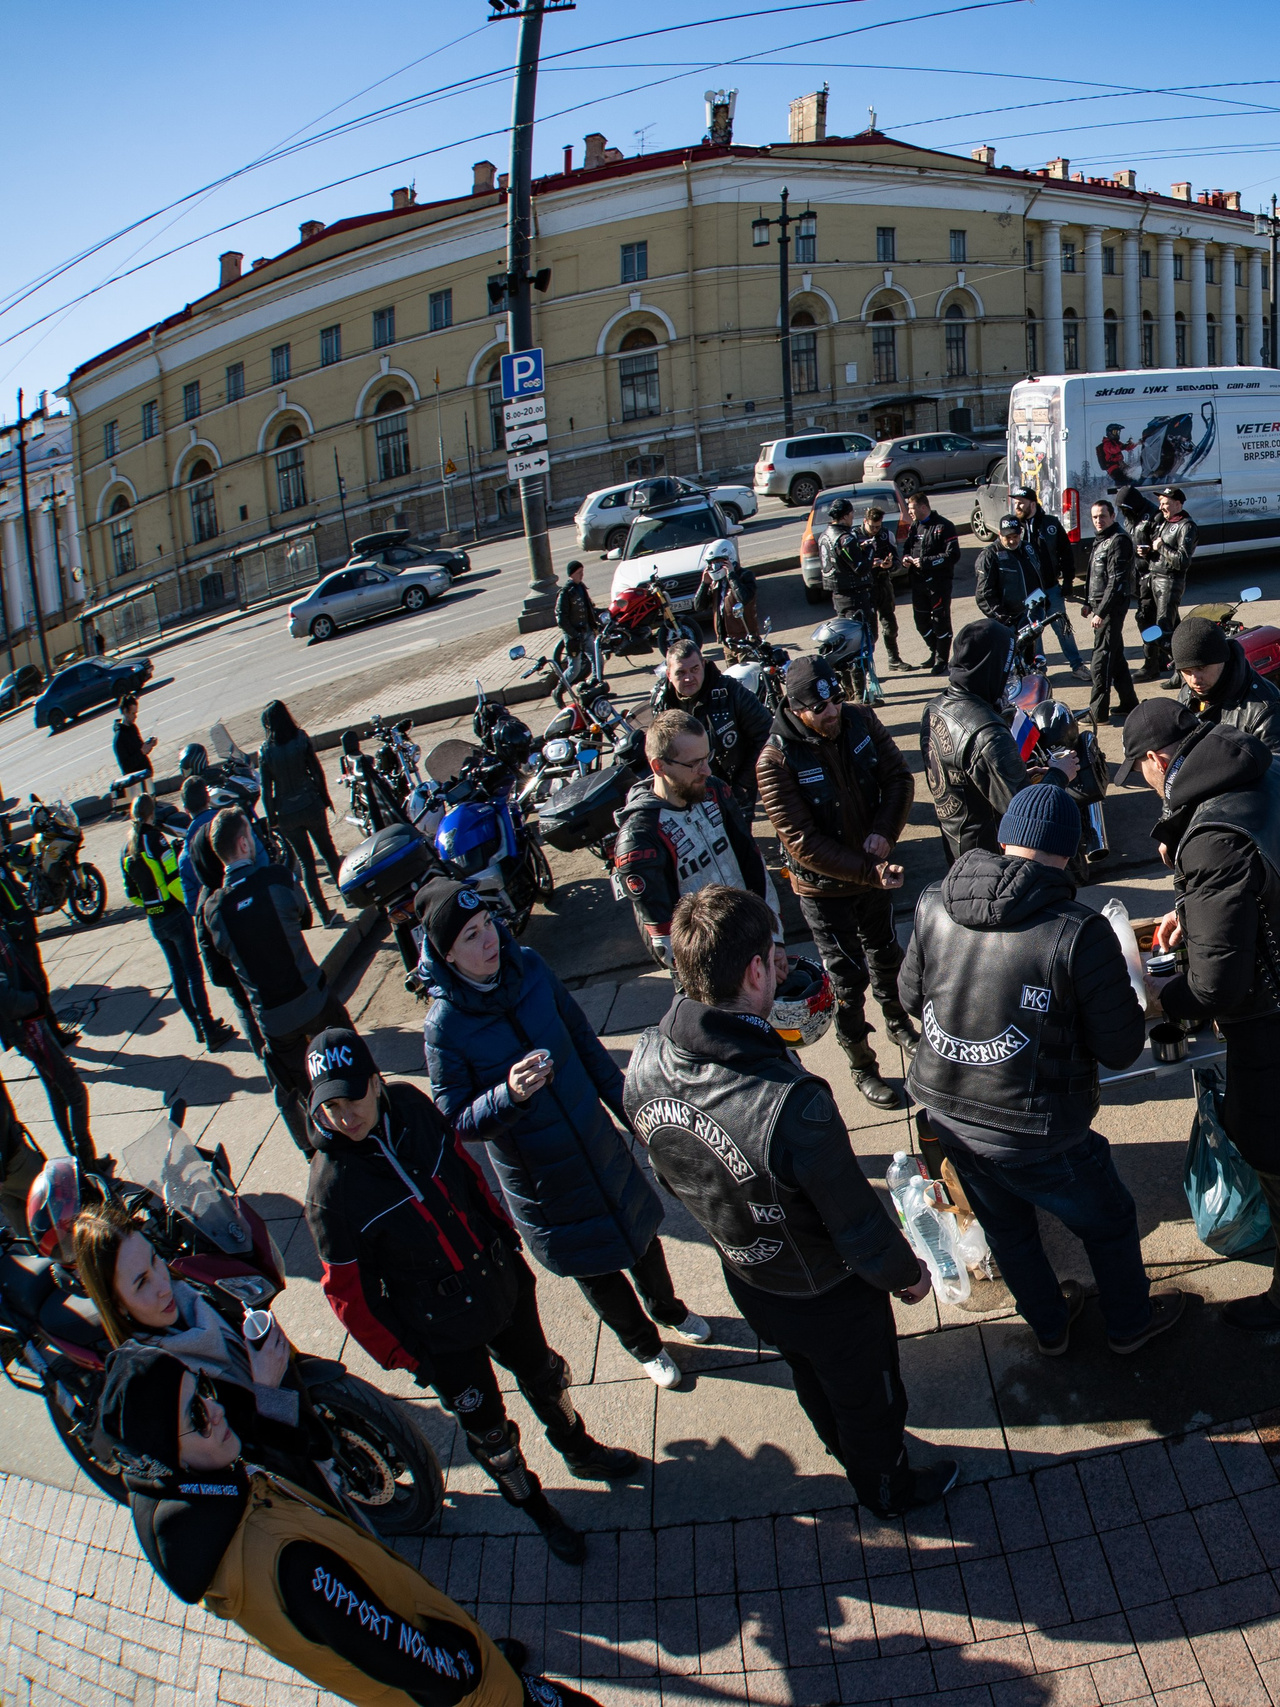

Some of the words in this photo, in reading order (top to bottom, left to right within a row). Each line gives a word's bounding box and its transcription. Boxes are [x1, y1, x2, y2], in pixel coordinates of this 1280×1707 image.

[512, 356, 535, 392] P
[1095, 387, 1135, 397] ski-doo
[1142, 385, 1169, 394] LYNX
[1227, 382, 1261, 390] can-am
[505, 405, 544, 421] 8.00-20.00
[1228, 496, 1267, 508] 336-70-70
[1023, 988, 1048, 1009] MC
[925, 1008, 1023, 1063] ST.PETERSBURG
[637, 1102, 691, 1139] NORMANS
[694, 1113, 749, 1177] RIDERS
[752, 1204, 783, 1222] MC
[312, 1566, 393, 1641] SUPPORT
